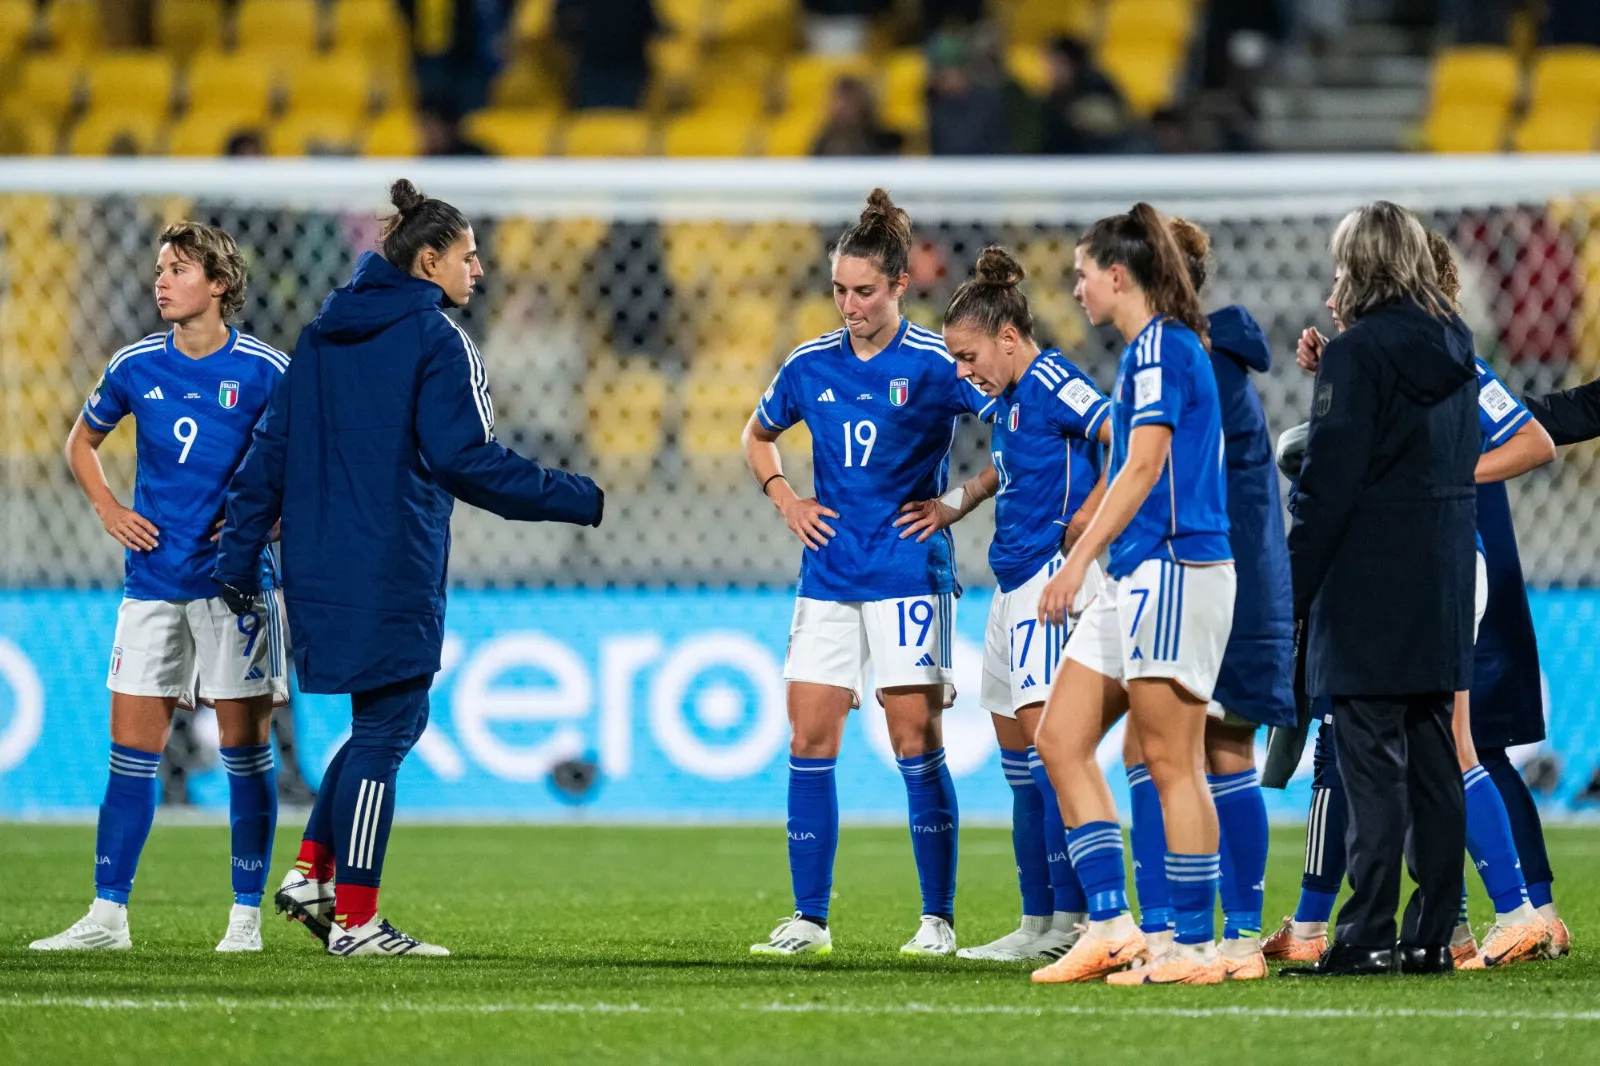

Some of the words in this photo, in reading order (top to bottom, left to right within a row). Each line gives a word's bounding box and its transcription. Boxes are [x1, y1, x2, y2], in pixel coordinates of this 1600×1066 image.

[173, 416, 198, 464] 9
[842, 420, 877, 468] 19
[236, 611, 262, 657] 9
[896, 600, 934, 647] 19
[1130, 588, 1150, 638] 7
[1010, 618, 1037, 673] 17
[913, 822, 954, 833] ITALIA
[230, 855, 263, 872] ITALIA
